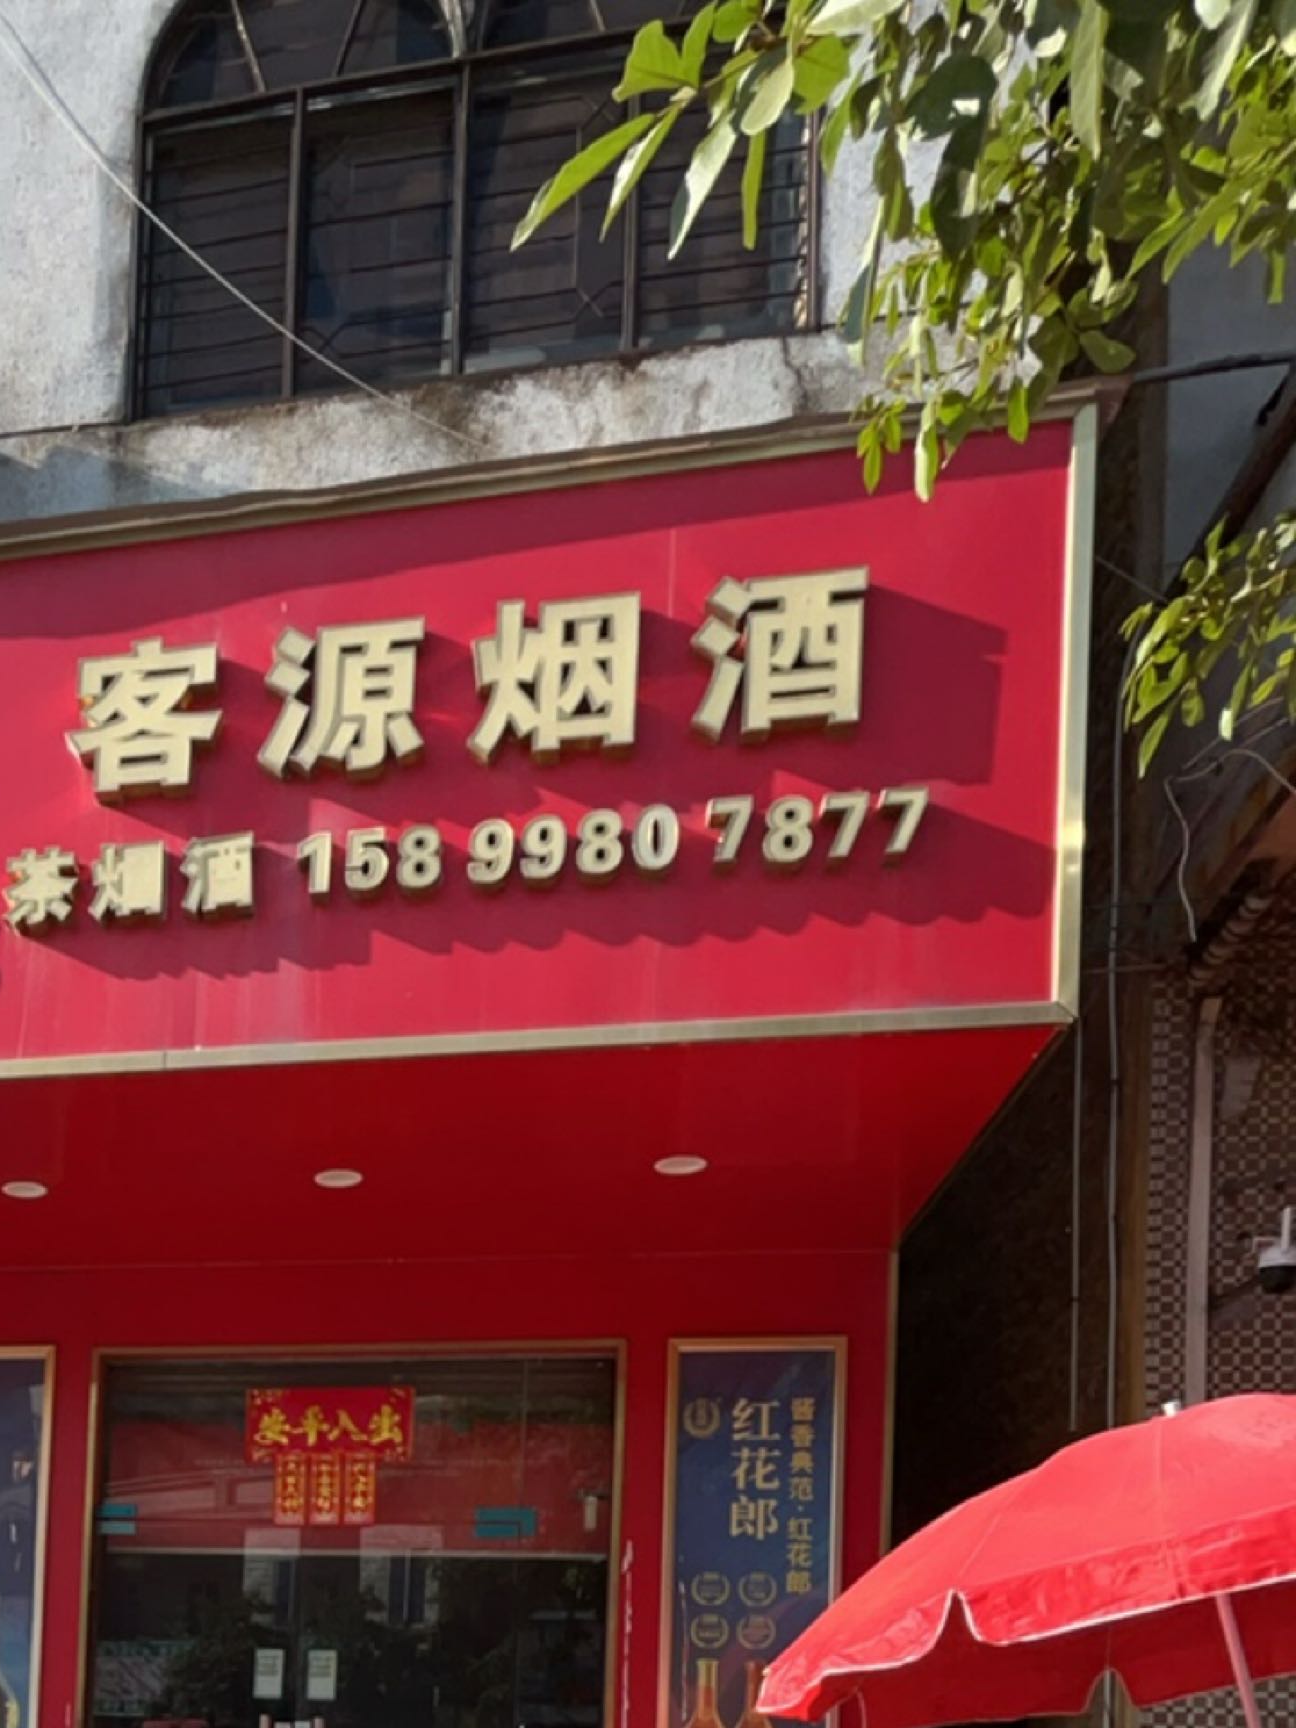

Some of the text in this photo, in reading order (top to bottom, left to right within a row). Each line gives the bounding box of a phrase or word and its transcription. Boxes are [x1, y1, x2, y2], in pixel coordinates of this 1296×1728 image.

[66, 566, 871, 793] 客源烟酒
[3, 787, 930, 930] 茶烟酒 158 9980 7877
[729, 1397, 781, 1540] 红花郎
